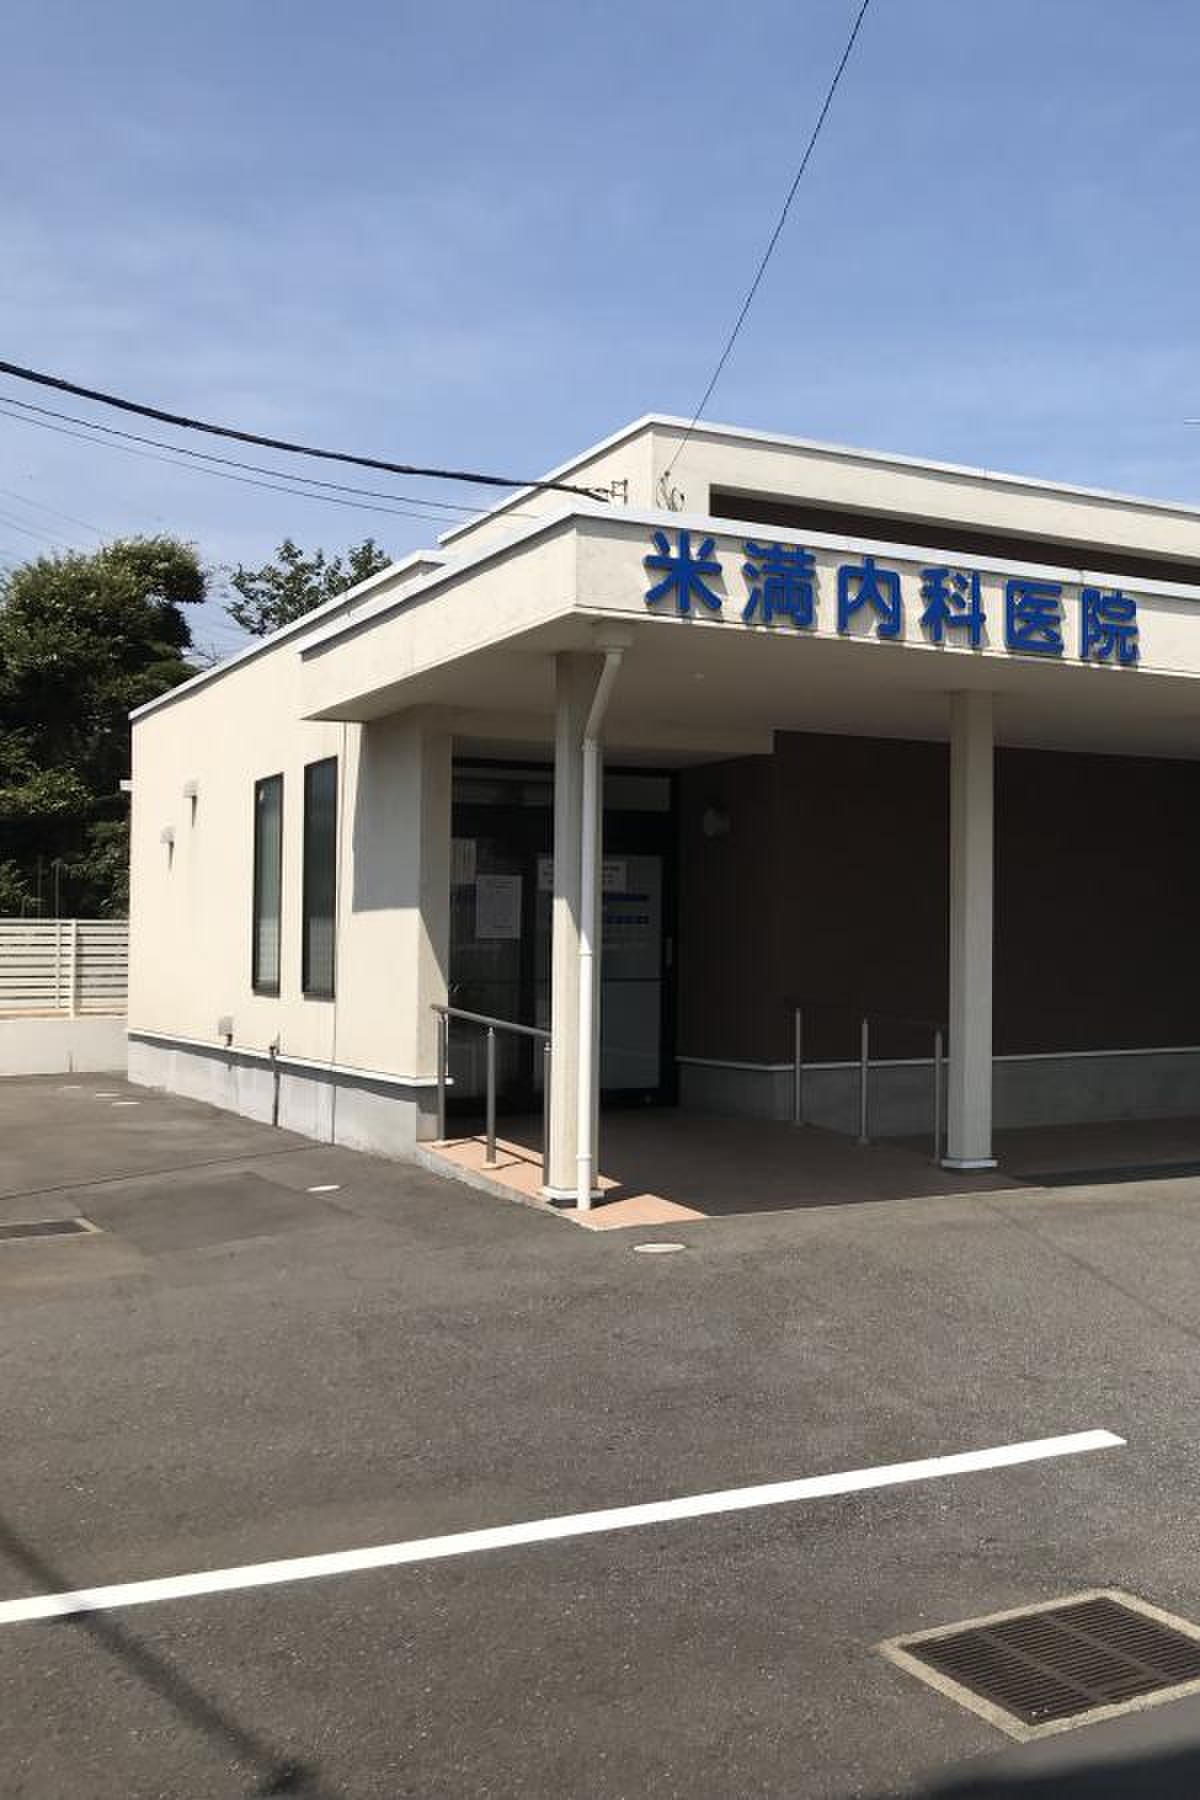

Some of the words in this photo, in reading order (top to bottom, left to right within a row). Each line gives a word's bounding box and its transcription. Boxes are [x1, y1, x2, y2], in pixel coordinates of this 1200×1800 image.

[643, 528, 1140, 664] 米満内科医院
